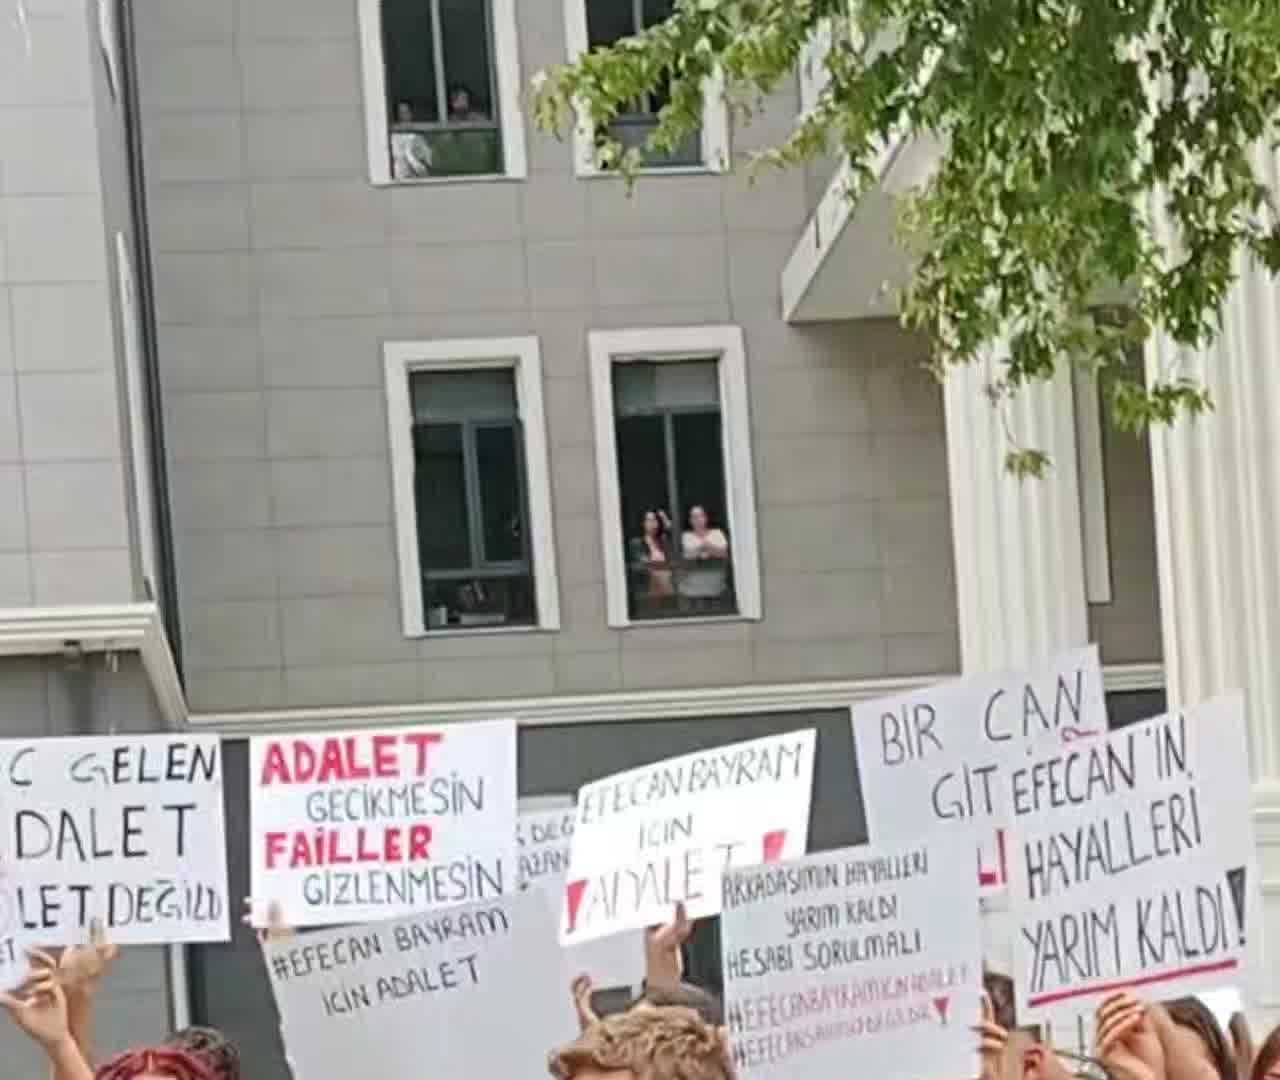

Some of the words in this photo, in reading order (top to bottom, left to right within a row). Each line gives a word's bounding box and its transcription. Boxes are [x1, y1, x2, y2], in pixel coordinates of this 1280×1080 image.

[984, 667, 1086, 744] CAN
[69, 743, 218, 785] GELEN
[260, 732, 444, 787] ADALET
[689, 742, 802, 793] BAYRAM
[264, 823, 433, 869] FAİLLER
[272, 932, 383, 982] #EFECAN
[394, 907, 509, 953] BAYRAM
[784, 902, 841, 940] YARIM
[726, 943, 794, 982] HESABI
[1021, 903, 1121, 993] YARIM
[377, 954, 480, 1001] ADALET
